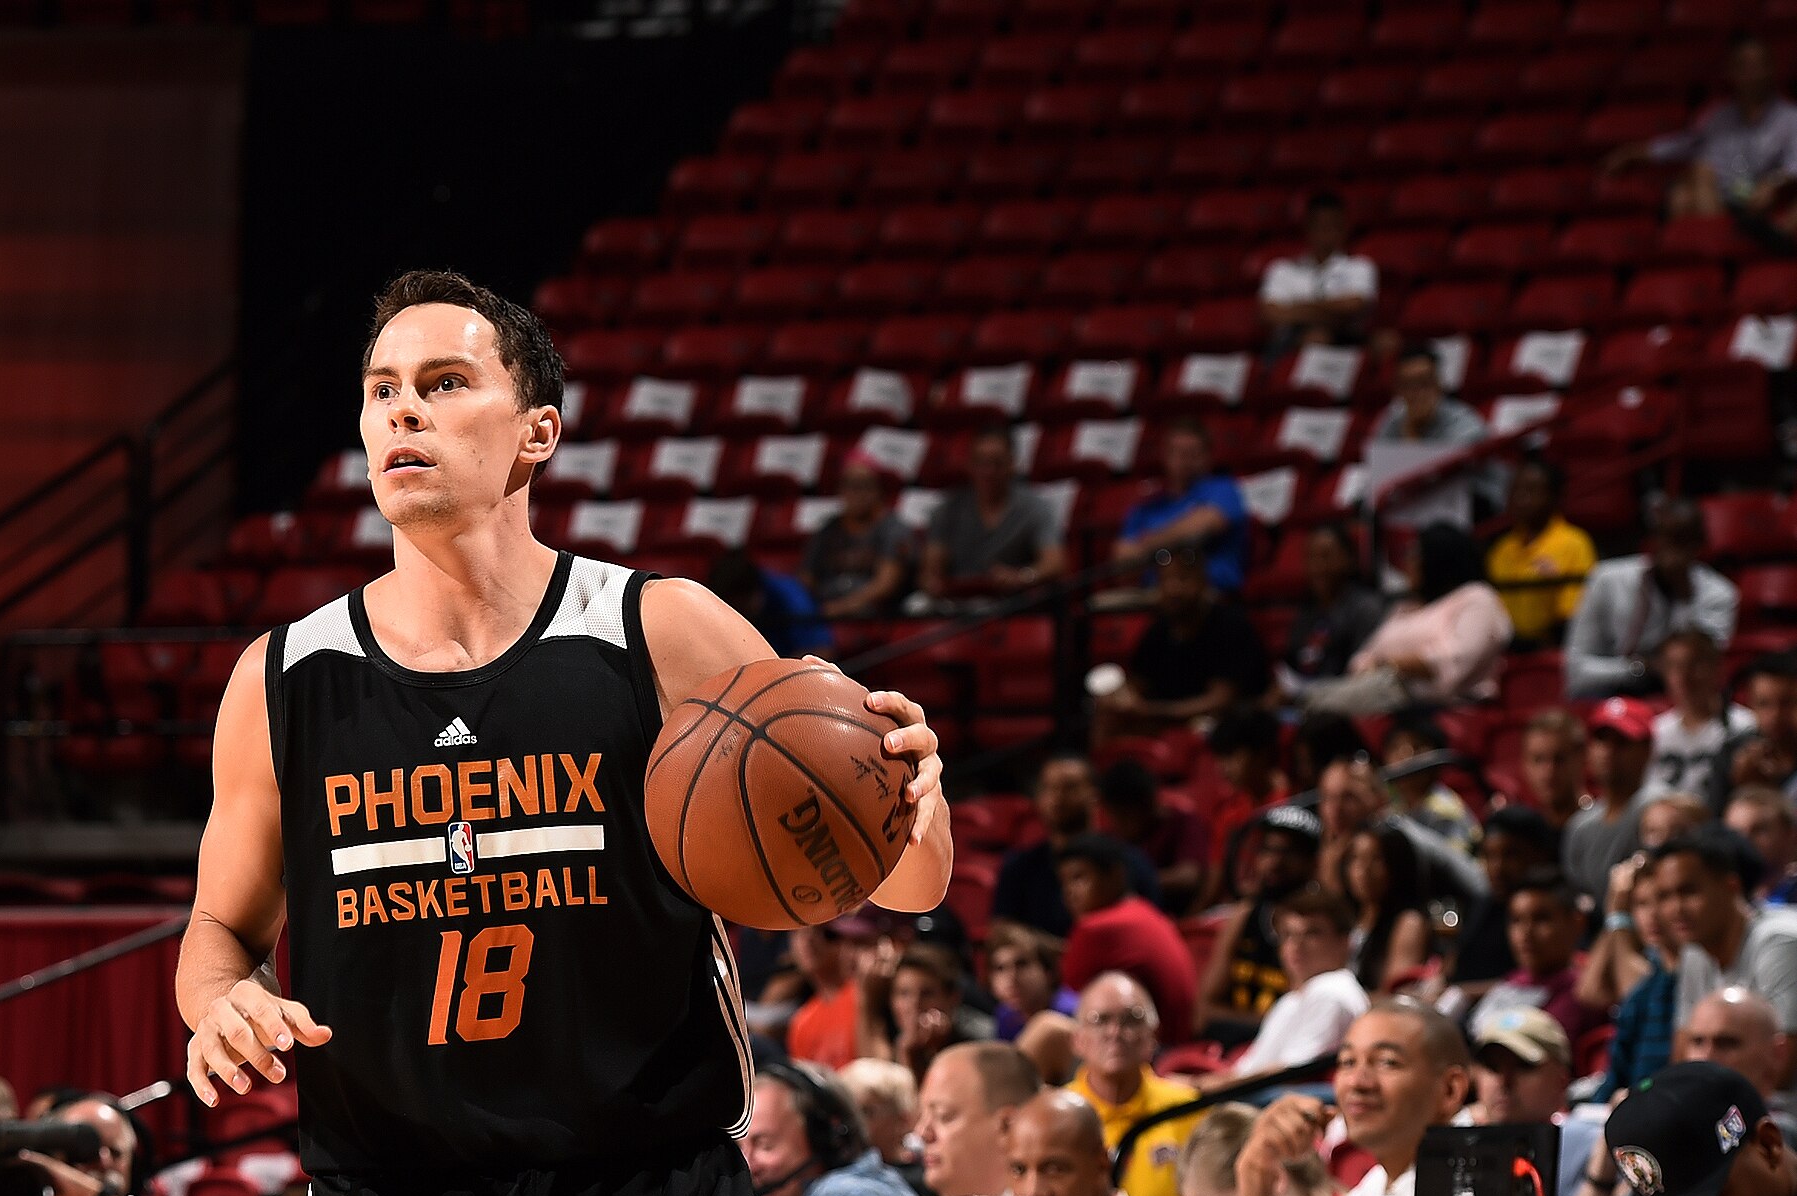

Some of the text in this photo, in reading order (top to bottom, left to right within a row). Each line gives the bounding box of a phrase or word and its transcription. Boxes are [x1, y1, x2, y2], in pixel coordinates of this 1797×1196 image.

[434, 734, 478, 747] adidas
[325, 753, 606, 836] PHOENIX
[336, 866, 608, 929] BASKETBALL
[428, 924, 535, 1045] 18
